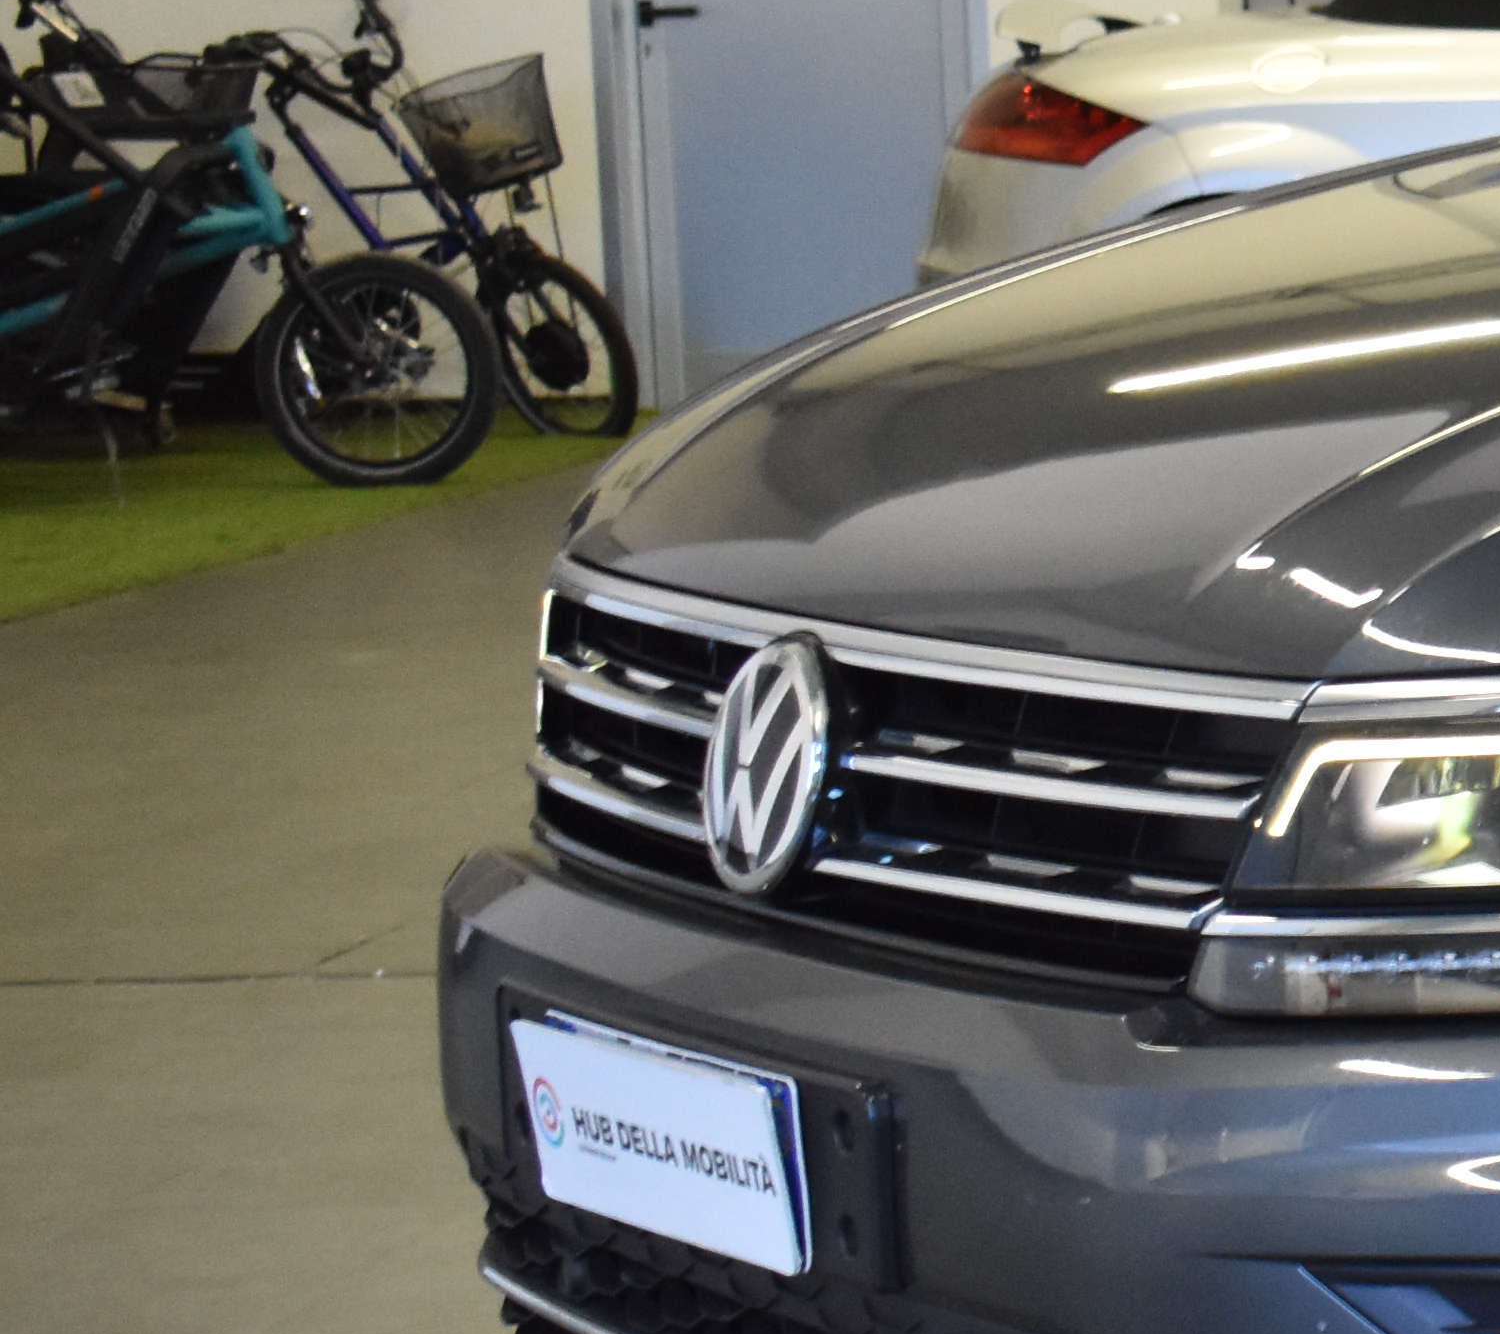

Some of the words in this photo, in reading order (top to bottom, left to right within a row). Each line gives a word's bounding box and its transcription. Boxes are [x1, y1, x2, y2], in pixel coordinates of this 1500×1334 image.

[573, 1109, 613, 1144] HUB
[617, 1121, 679, 1167] DELLA
[682, 1140, 775, 1196] MOBILITÀ
